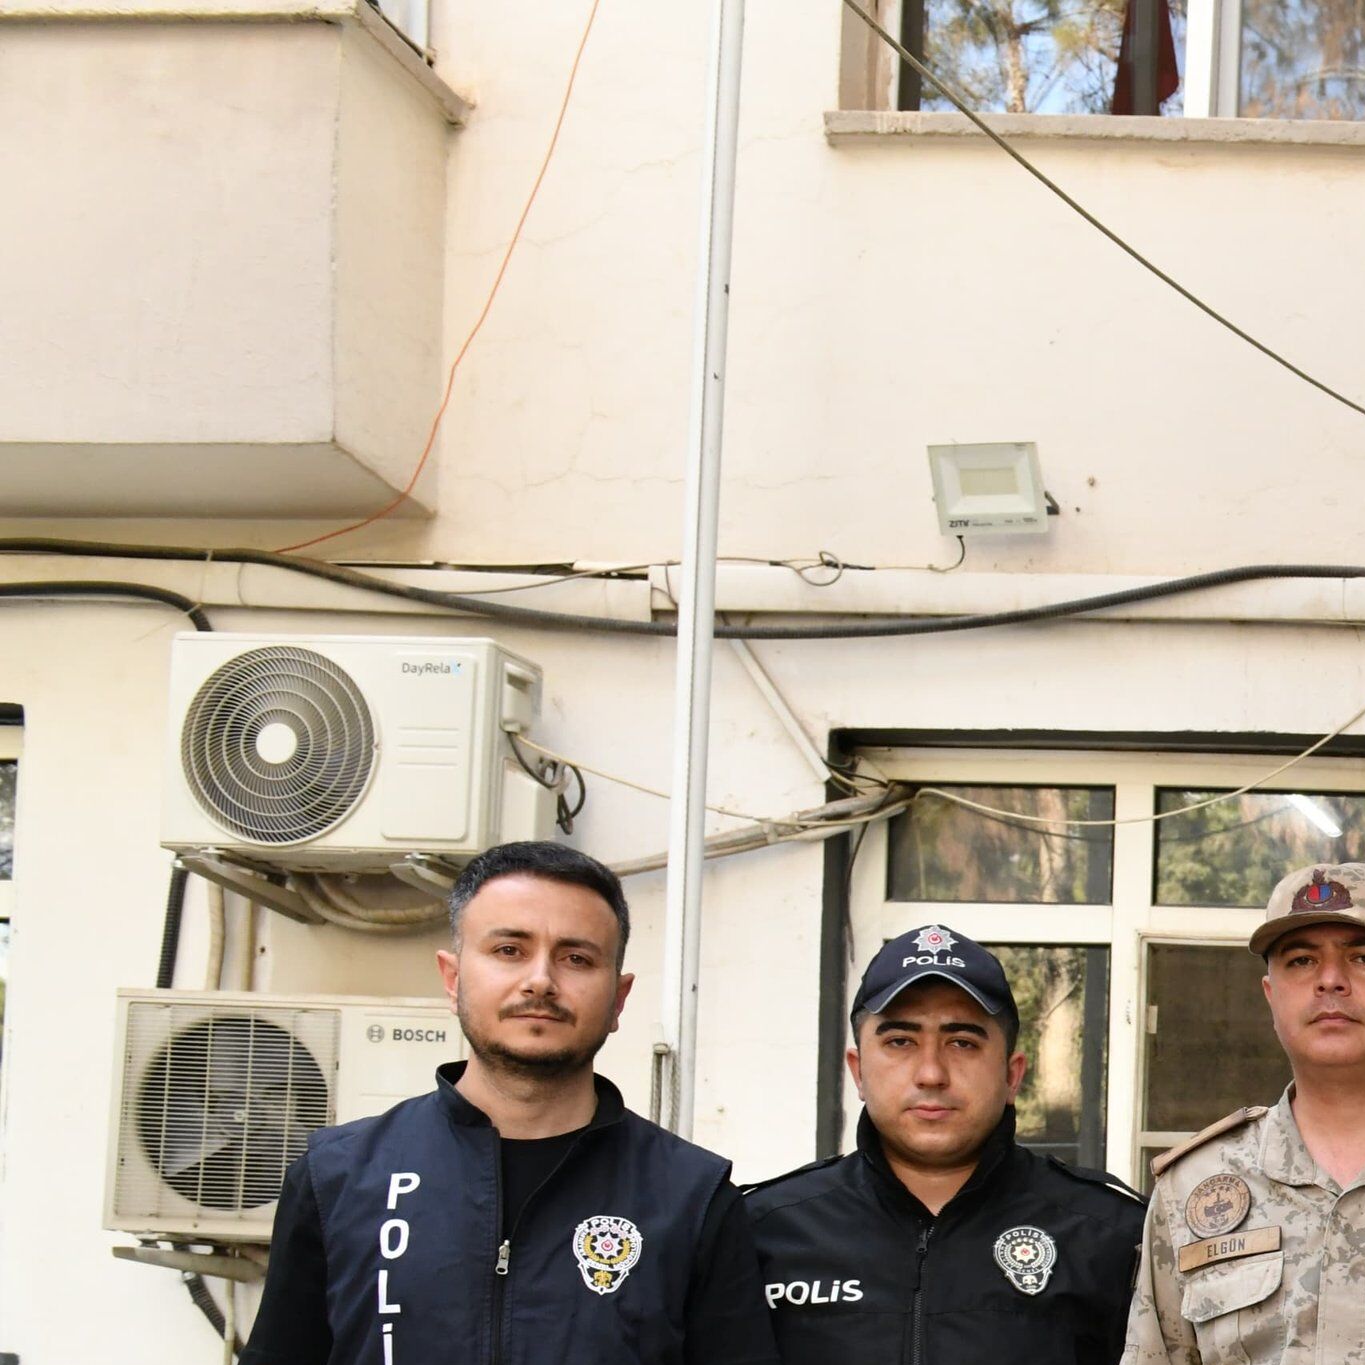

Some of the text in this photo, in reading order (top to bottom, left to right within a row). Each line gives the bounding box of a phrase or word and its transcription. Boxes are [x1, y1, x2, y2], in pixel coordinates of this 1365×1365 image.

[401, 661, 461, 677] DayRela
[901, 955, 966, 968] POLİS
[392, 1028, 446, 1042] BOSCH
[1206, 1237, 1246, 1259] ELGÜN
[764, 1279, 864, 1310] POLİS
